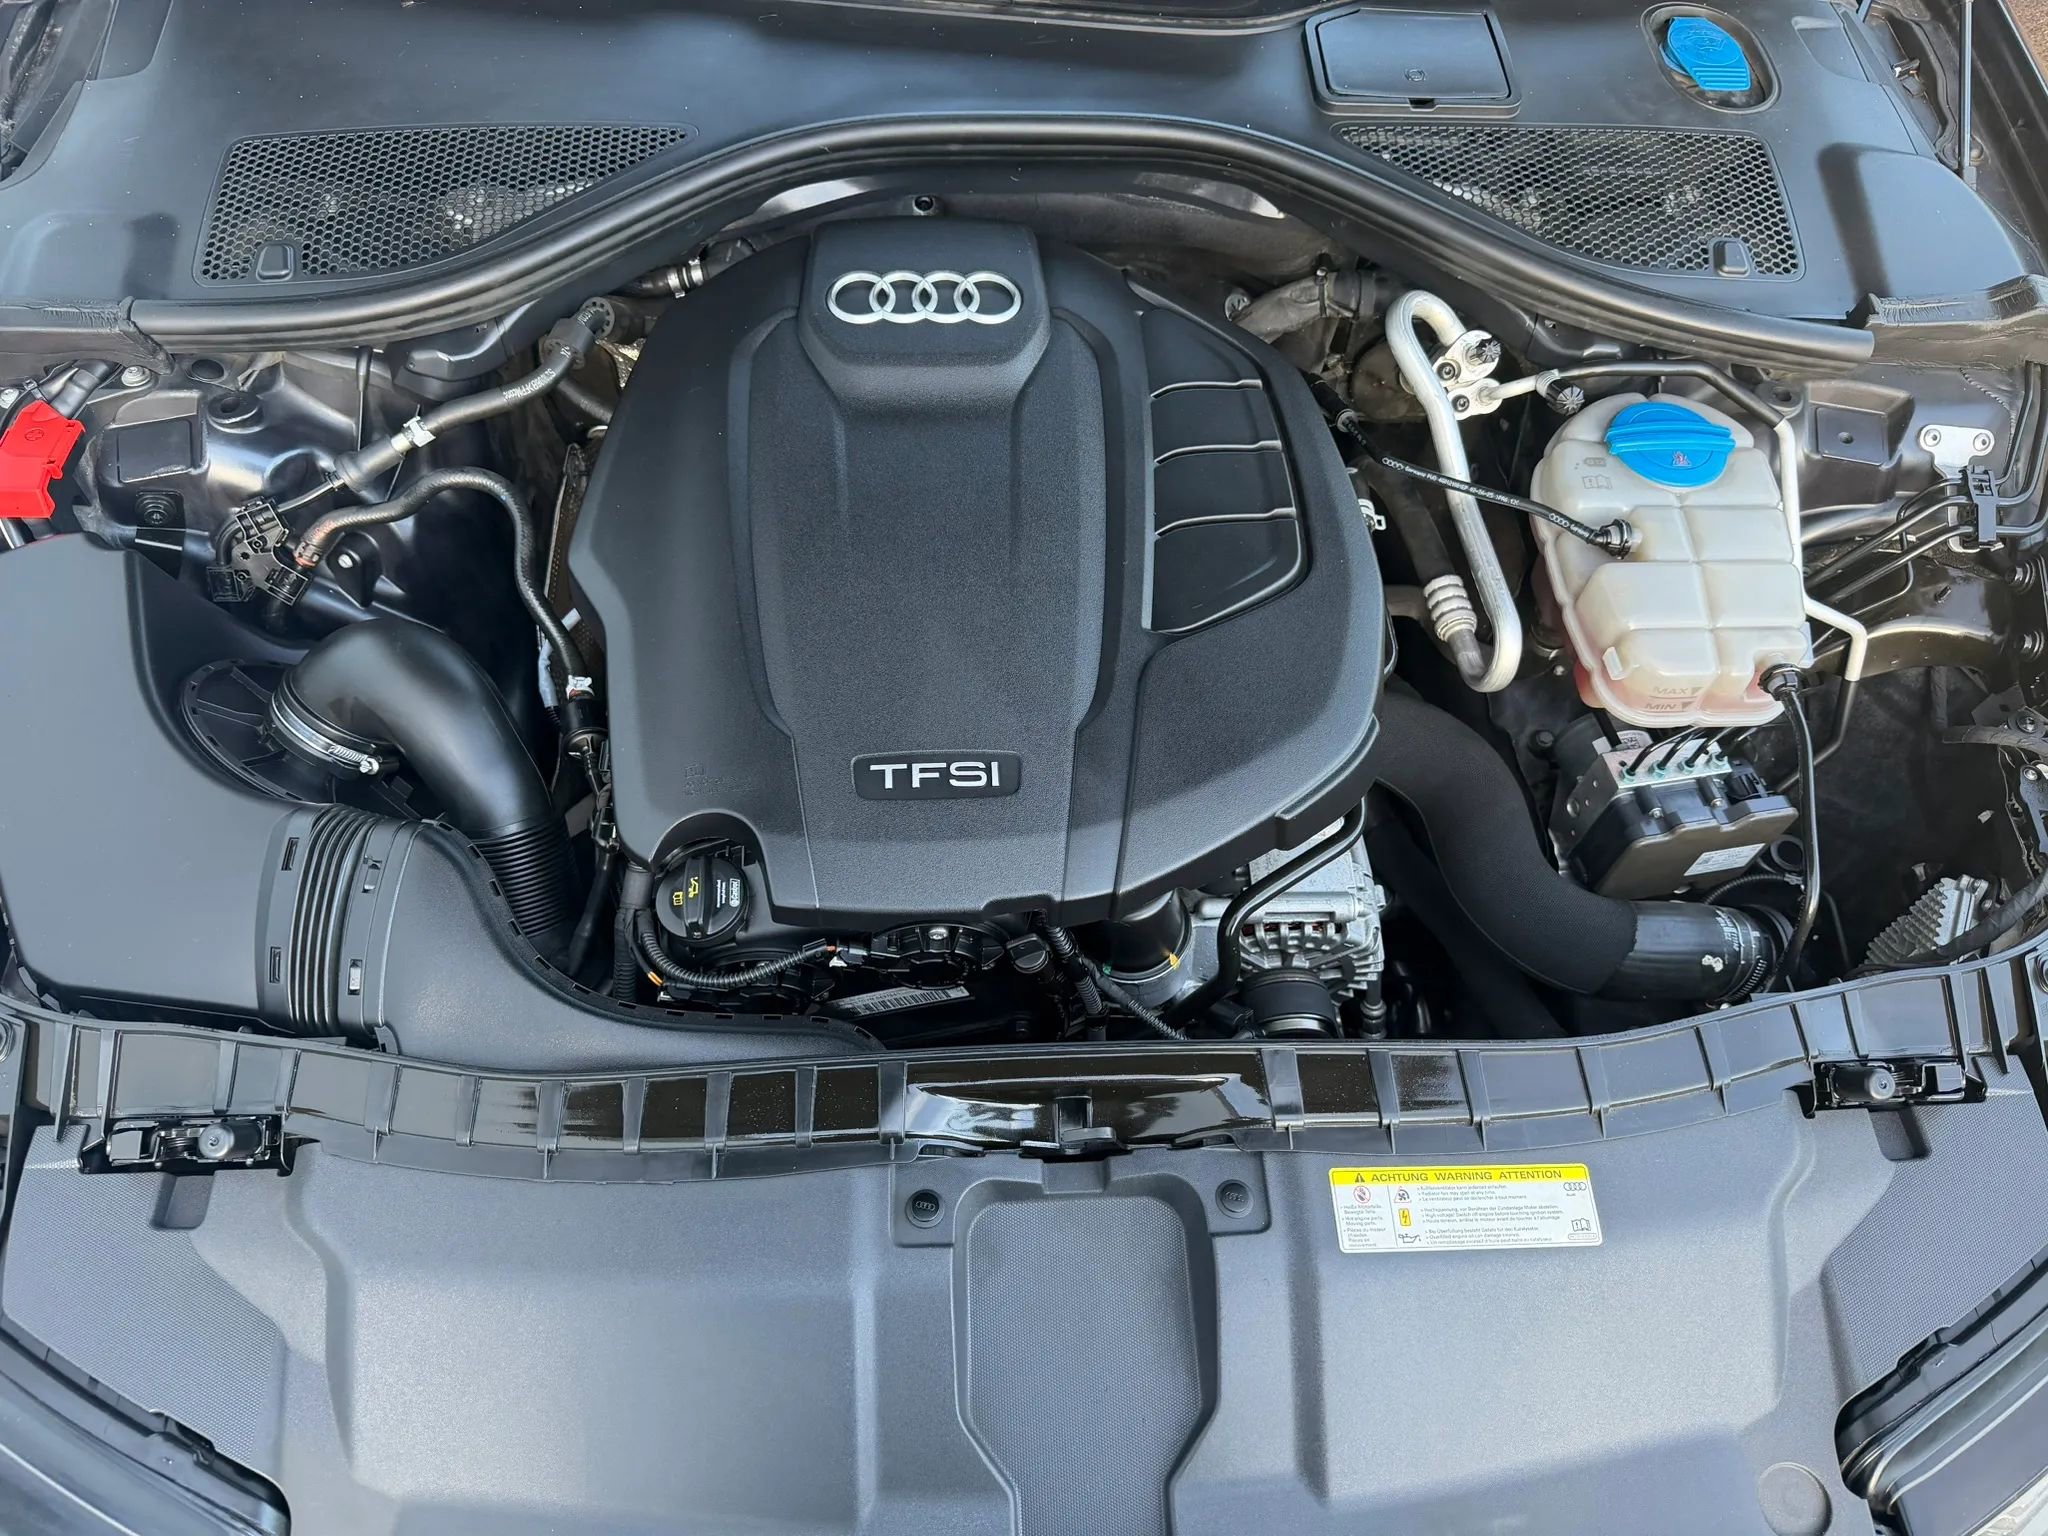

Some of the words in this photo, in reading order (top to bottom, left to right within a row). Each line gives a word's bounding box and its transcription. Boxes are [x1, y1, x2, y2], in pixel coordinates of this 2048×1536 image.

[1653, 686, 1688, 695] MAX
[870, 762, 1000, 789] TFSI
[1371, 1172, 1428, 1182] ACHTUNG
[1434, 1172, 1492, 1181] WARNING
[1499, 1170, 1562, 1180] ATTENTION
